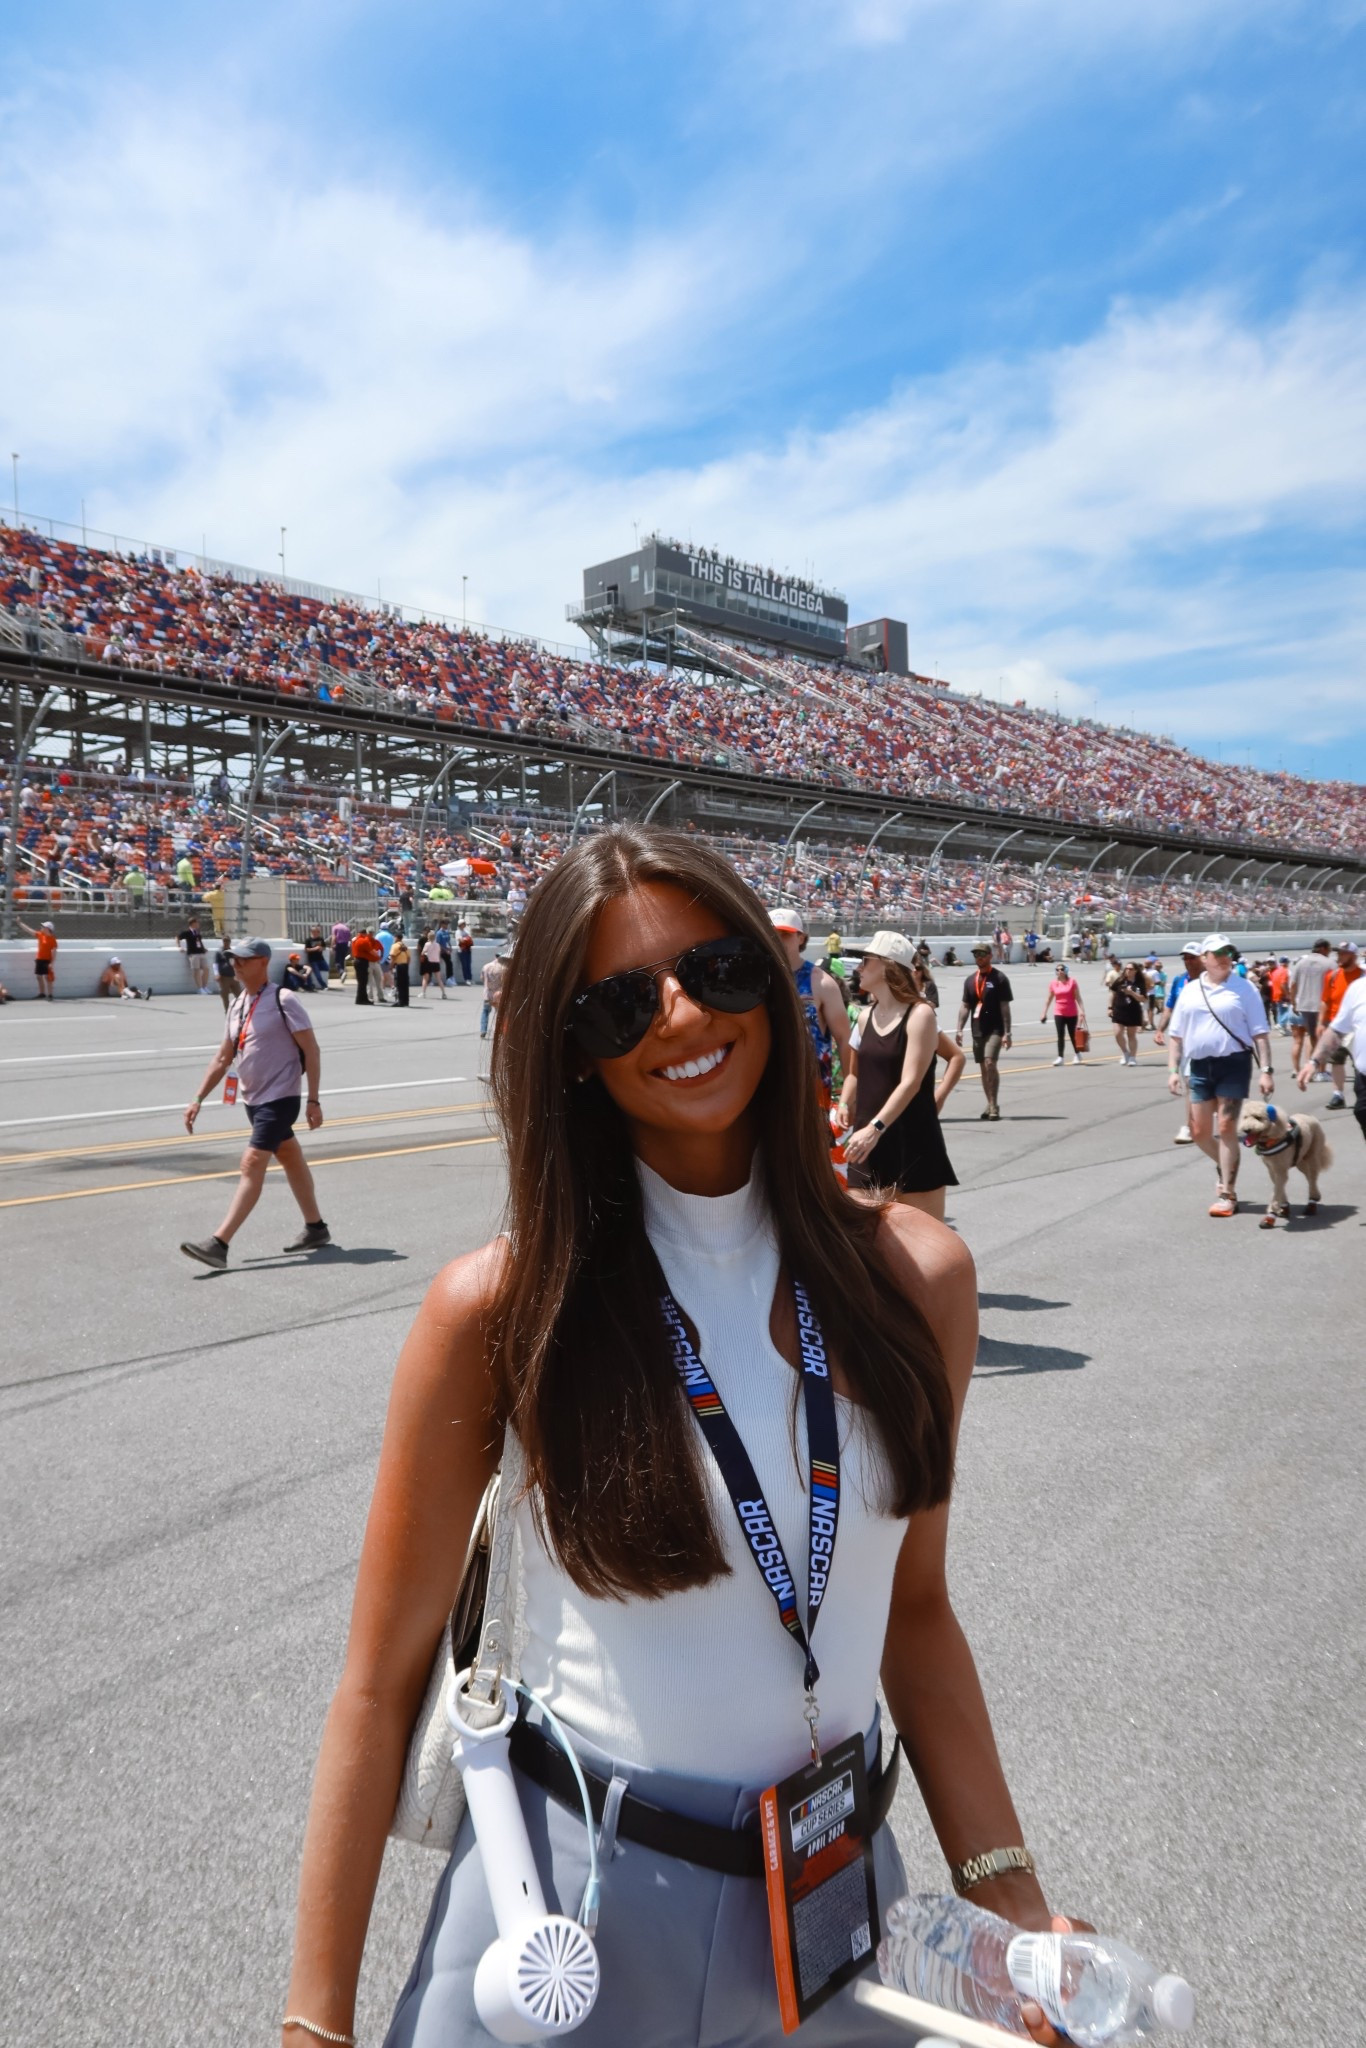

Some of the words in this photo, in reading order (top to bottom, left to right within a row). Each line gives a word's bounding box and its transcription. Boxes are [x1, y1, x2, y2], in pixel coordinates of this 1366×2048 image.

[689, 556, 724, 585] THIS
[728, 568, 742, 590] IS
[745, 575, 824, 615] TALLADEGA
[738, 1498, 795, 1601] NASCAR
[809, 1496, 837, 1606] NASCAR
[765, 1800, 774, 1818] PIT
[811, 1779, 843, 1812] NASCAR
[801, 1815, 817, 1837] CUP
[817, 1796, 846, 1825] SERIES
[807, 1834, 826, 1859] APRIL
